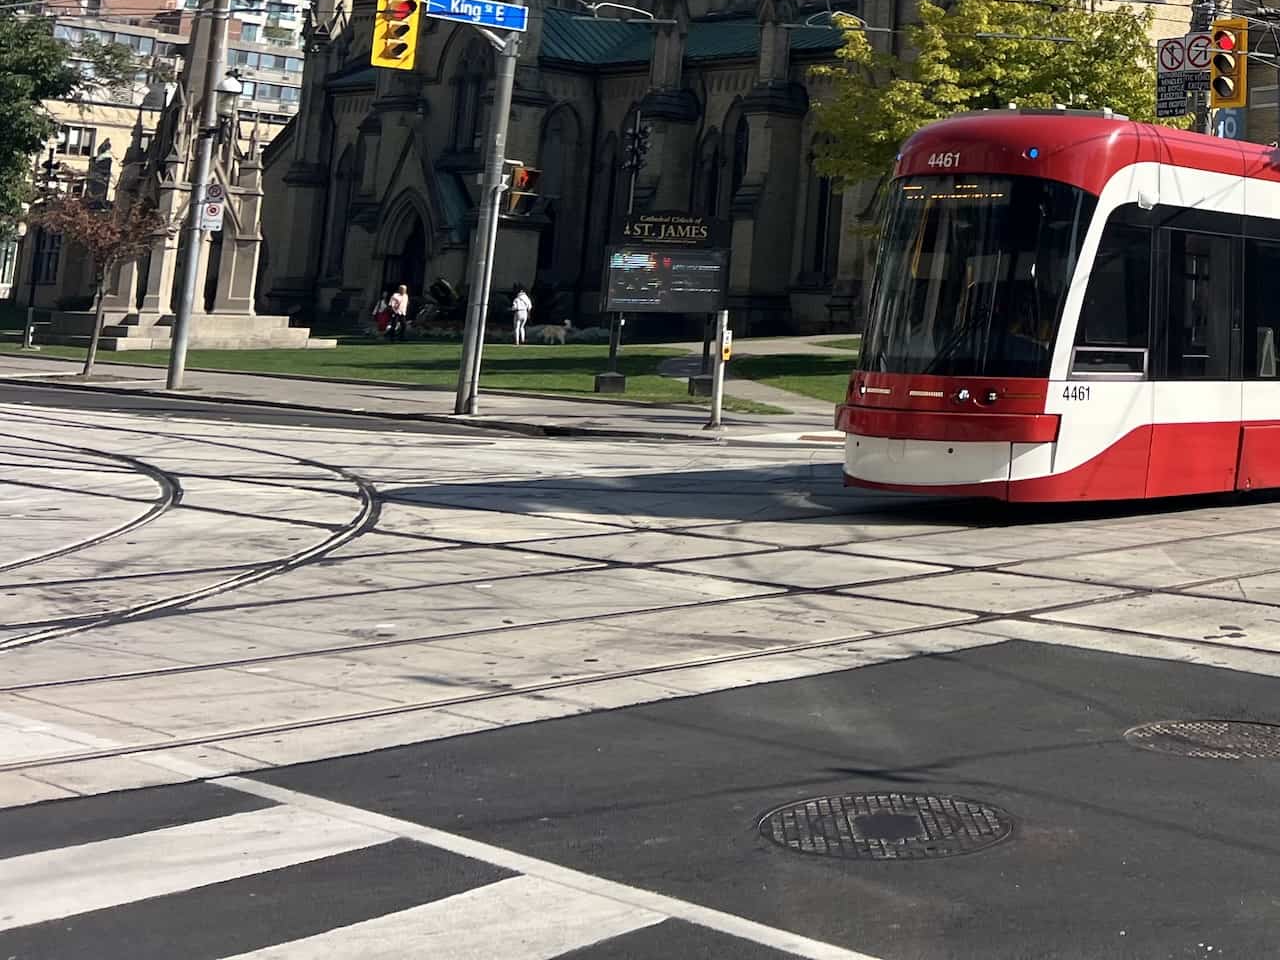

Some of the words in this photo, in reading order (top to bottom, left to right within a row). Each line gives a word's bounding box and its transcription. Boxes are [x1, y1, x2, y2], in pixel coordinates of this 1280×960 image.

[495, 6, 505, 22] E
[927, 152, 961, 168] 4461
[633, 223, 656, 237] ST.
[658, 225, 708, 239] JAMES
[1062, 384, 1090, 401] 4461
